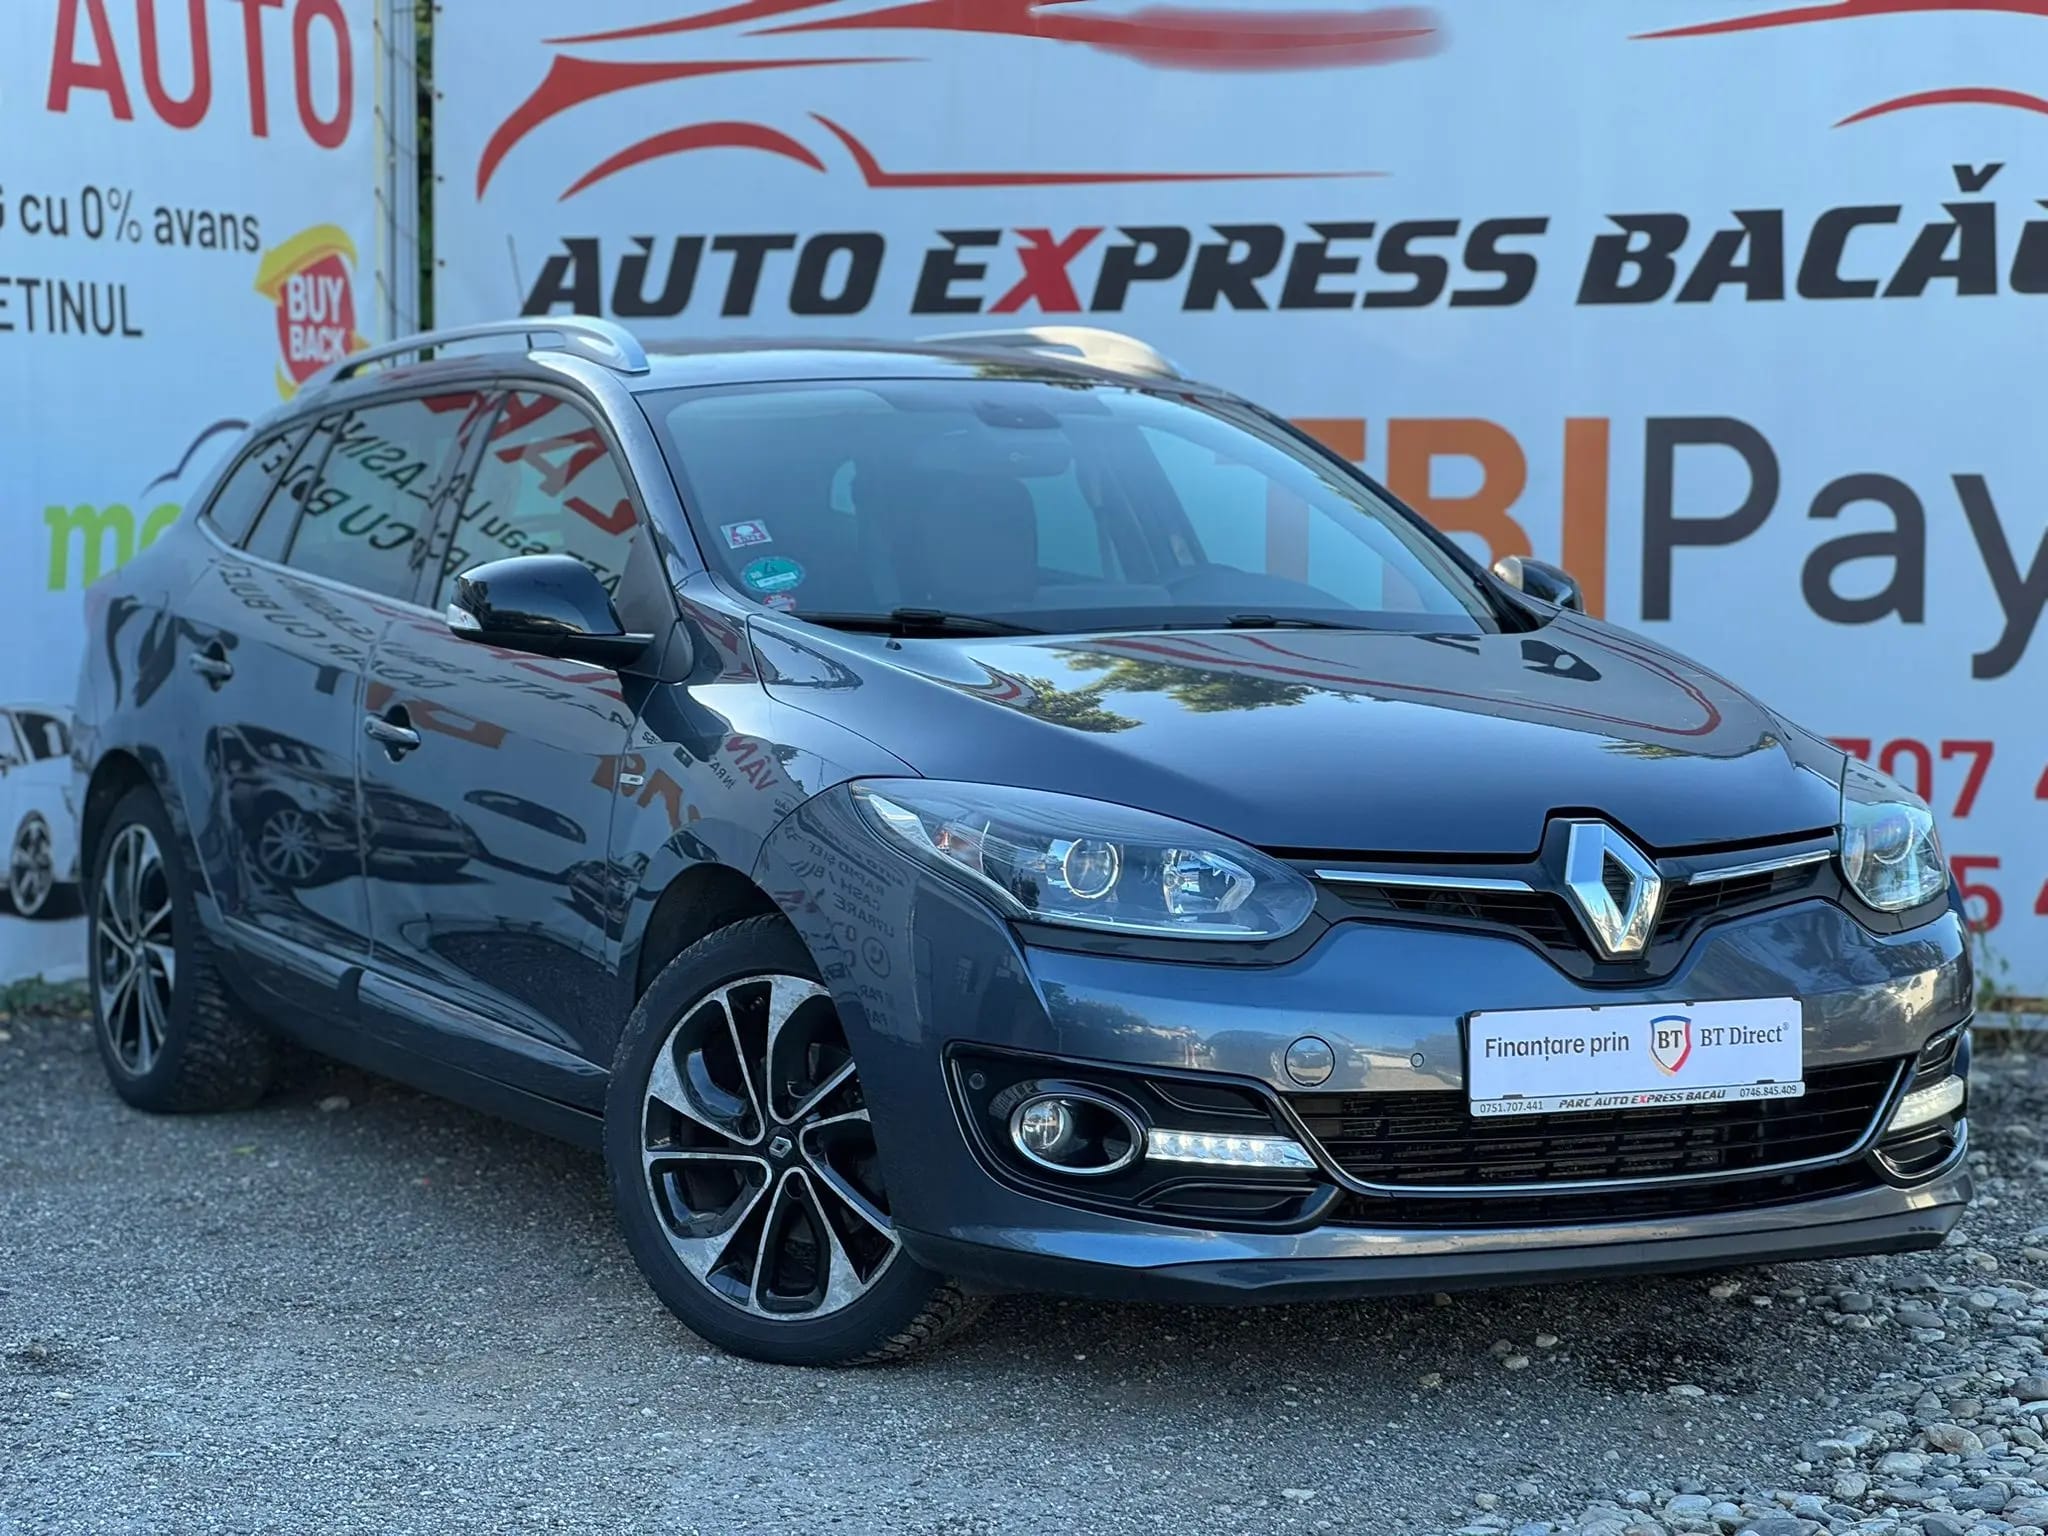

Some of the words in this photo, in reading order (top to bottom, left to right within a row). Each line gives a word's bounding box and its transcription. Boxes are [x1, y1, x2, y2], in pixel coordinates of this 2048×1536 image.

[47, 0, 353, 149] AUTO
[19, 194, 68, 236] cu
[81, 184, 143, 243] 0%
[154, 206, 260, 252] avans
[519, 232, 886, 317] AUTO
[910, 216, 1550, 315] EXPRESS
[286, 272, 345, 323] BUY
[289, 326, 347, 362] BACK
[1826, 738, 1994, 819] 07
[1485, 1036, 1585, 1061] Finanțare
[1590, 1031, 1630, 1057] prin
[1657, 1030, 1683, 1049] BT
[1700, 1028, 1724, 1047] BT
[1480, 1101, 1544, 1113] 0751.707.441
[1559, 1098, 1593, 1109] PARC
[1594, 1095, 1629, 1107] AUTO
[1630, 1091, 1684, 1104] EXPRESS
[1739, 1085, 1797, 1098] 0746.845.409
